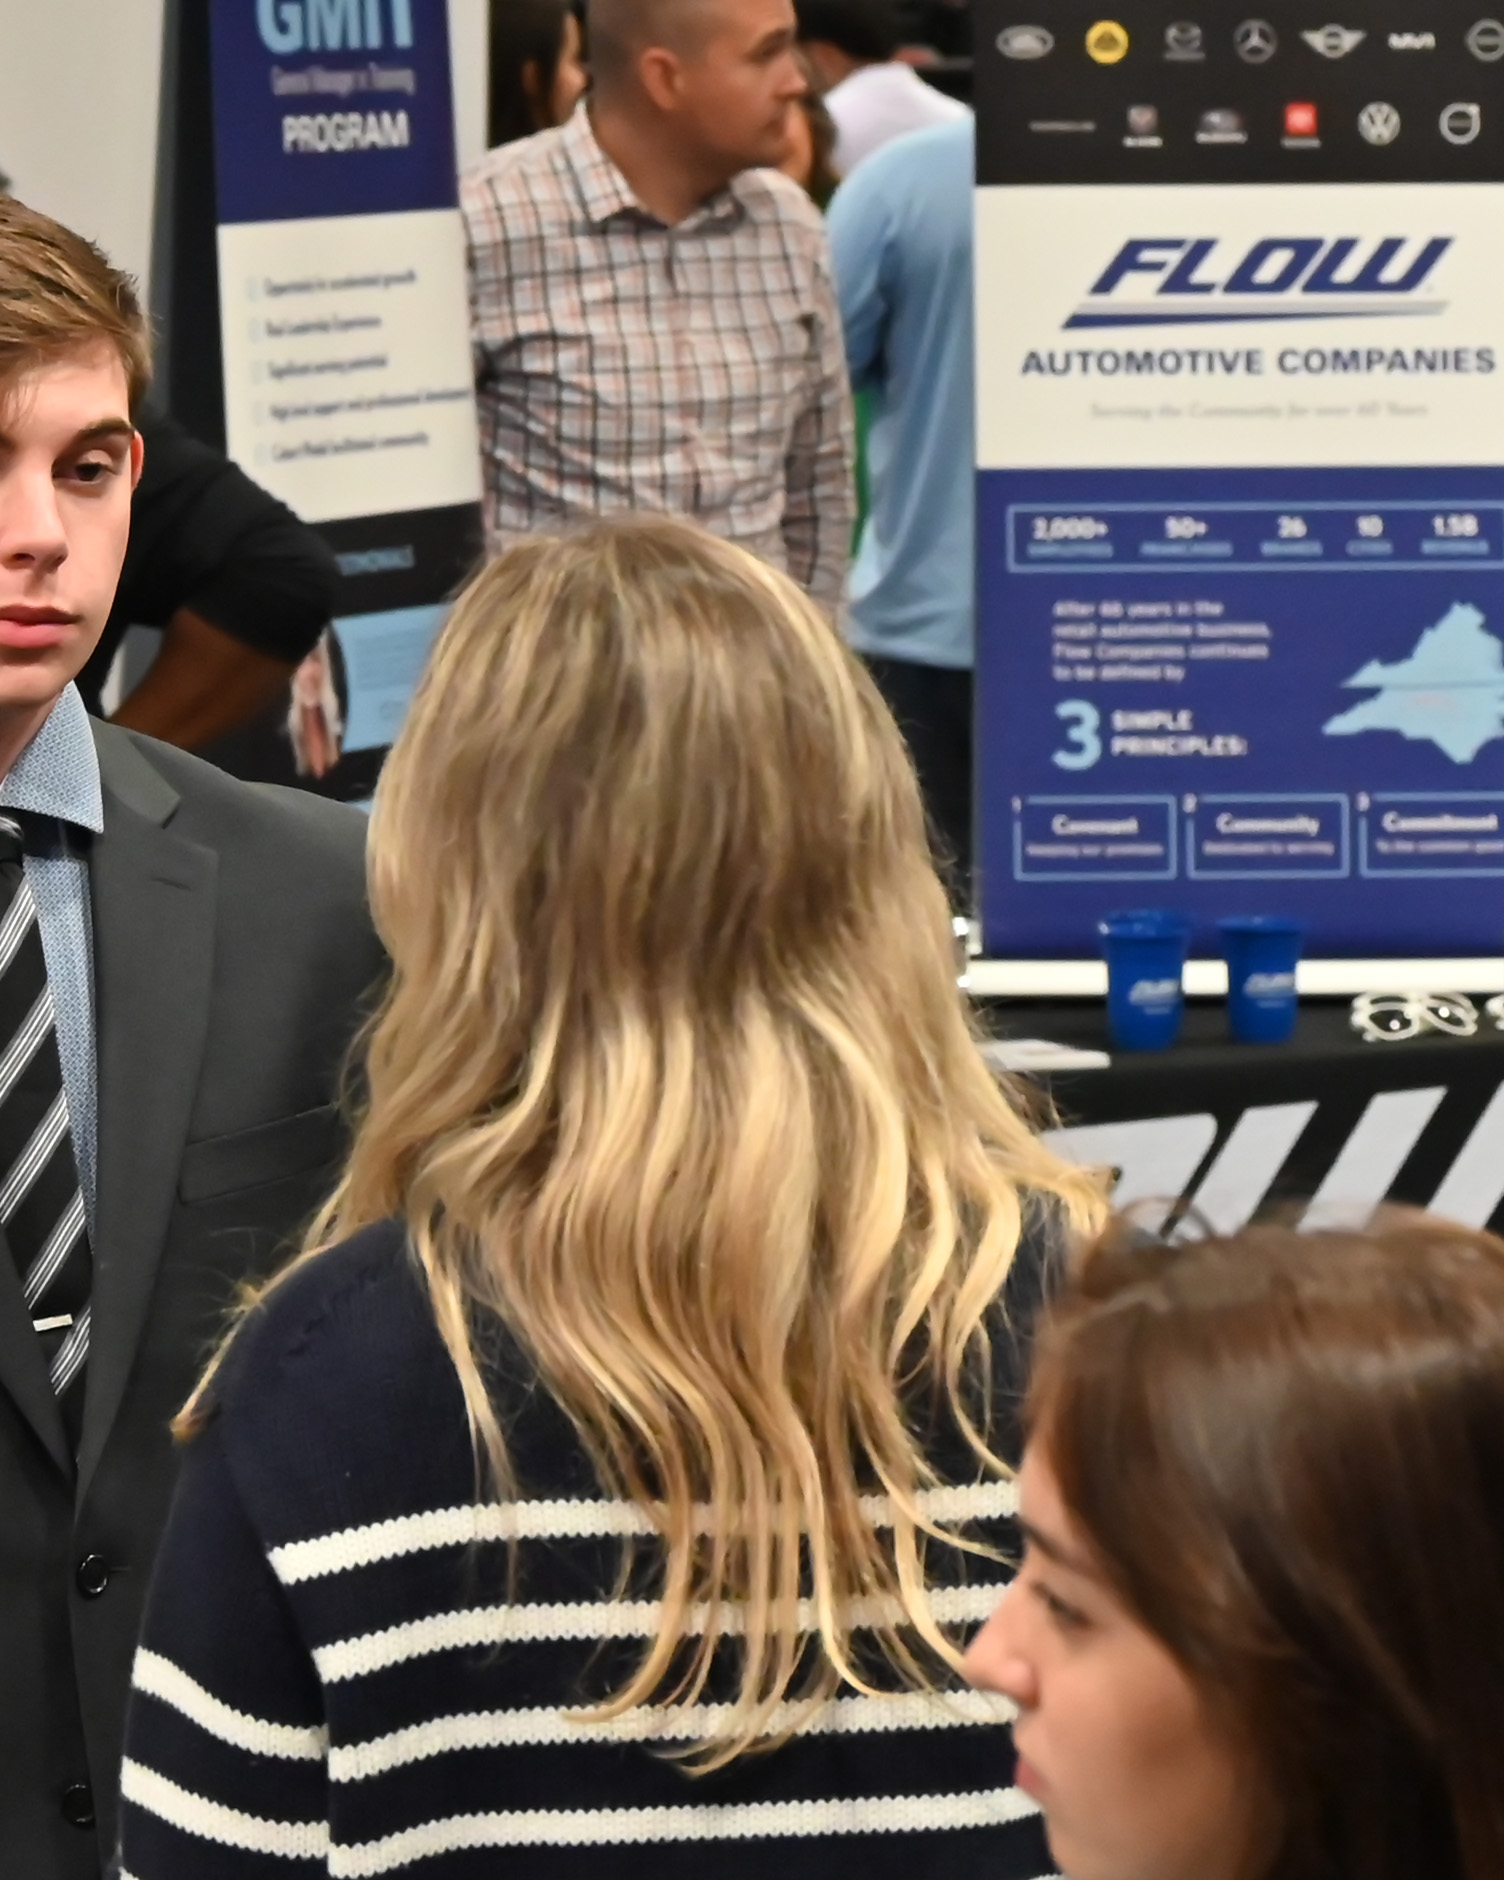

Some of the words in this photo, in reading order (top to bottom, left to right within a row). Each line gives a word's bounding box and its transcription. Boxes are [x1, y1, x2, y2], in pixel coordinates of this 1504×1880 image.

[282, 109, 410, 154] PROGRAM
[1088, 237, 1454, 296] FLOW
[1021, 348, 1264, 377] AUTOMOTIVE
[1277, 347, 1497, 375] COMPANIES
[1052, 699, 1102, 771] 3
[1111, 709, 1194, 732] SIMPLE
[1215, 811, 1321, 837] Community
[1382, 810, 1499, 833] Commitment
